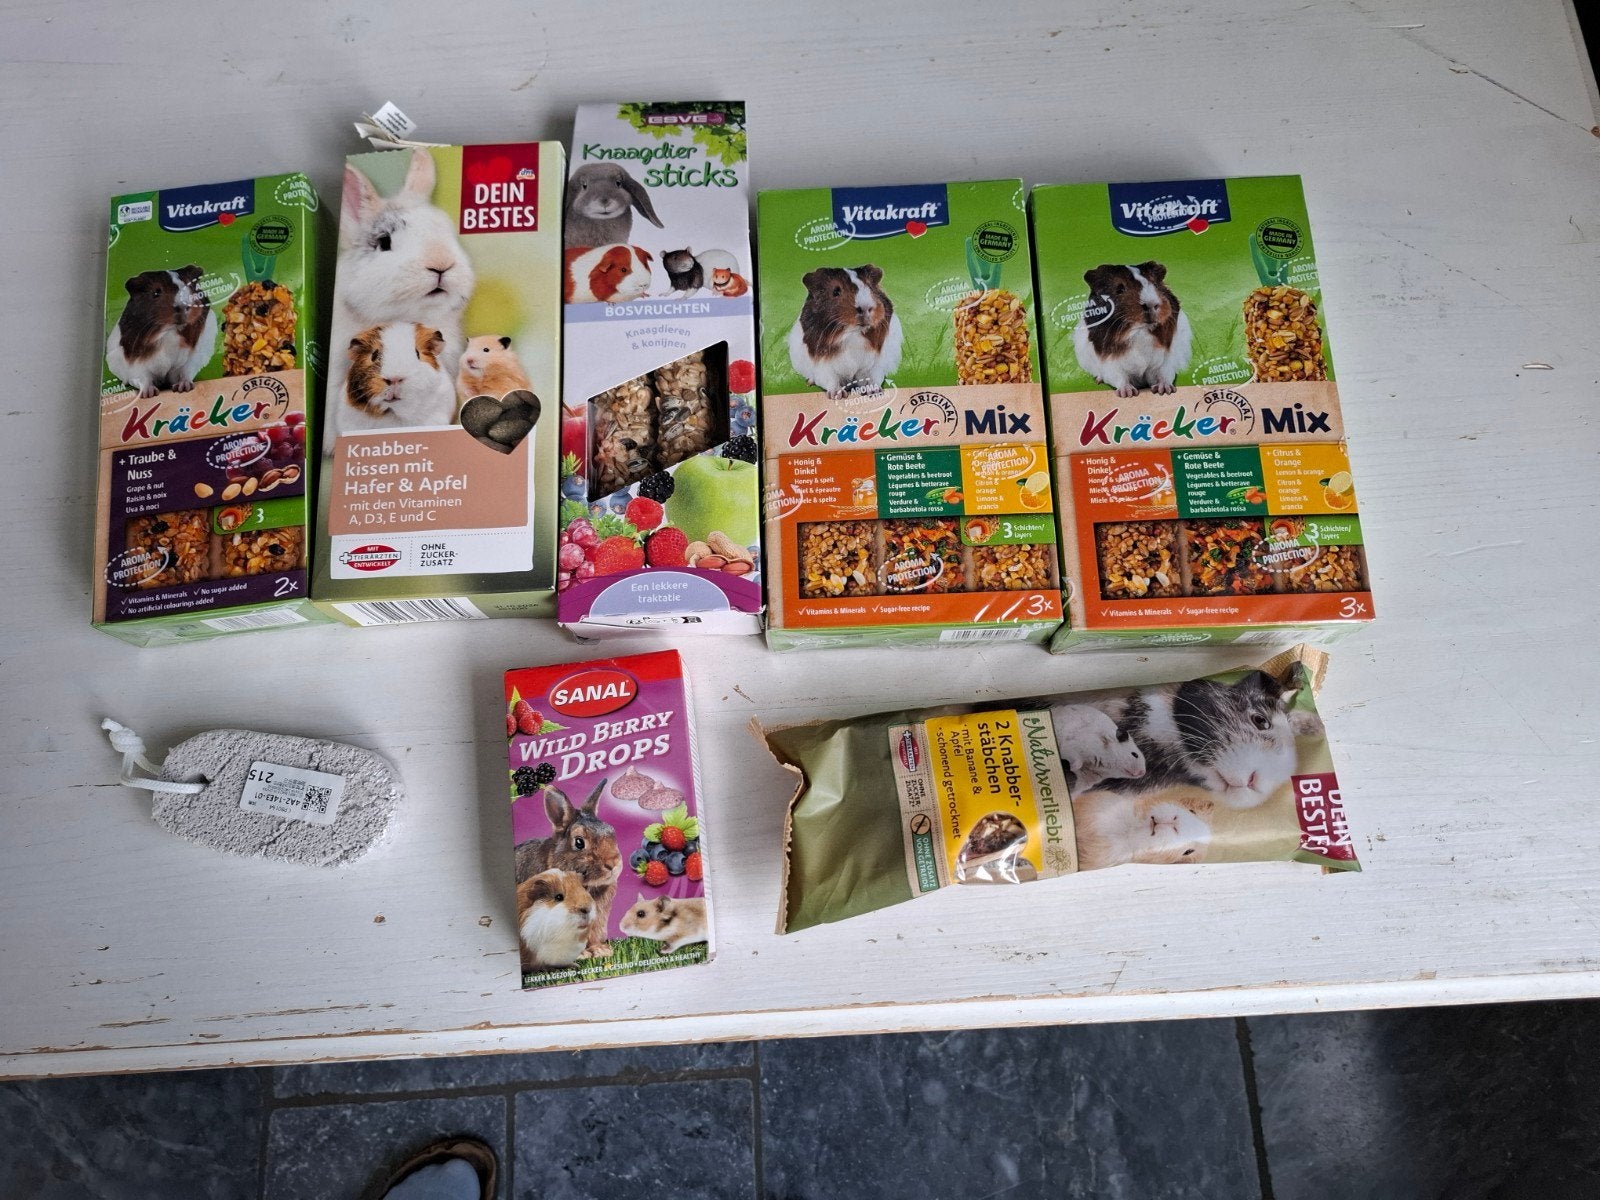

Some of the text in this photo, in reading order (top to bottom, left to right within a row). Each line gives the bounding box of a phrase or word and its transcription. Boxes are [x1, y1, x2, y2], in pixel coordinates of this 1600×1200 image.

[647, 114, 708, 124] ESVE
[582, 142, 697, 165] Knaagdier
[644, 161, 738, 187] sticks
[474, 182, 524, 203] DEIN
[166, 196, 246, 219] Vitakraft
[842, 202, 937, 223] Vitakraft
[1119, 198, 1218, 218] Vitakraft
[463, 205, 535, 230] BESTES
[810, 222, 837, 235] AROMA
[803, 229, 849, 245] PROTECTION
[195, 276, 223, 292] AROMA
[940, 281, 970, 295] AROMA
[188, 282, 234, 303] PROTECTION
[934, 289, 979, 305] PROTECTION
[605, 303, 710, 317] BOSVRUCHTEN
[1060, 305, 1107, 322] PROTECTION
[1067, 299, 1096, 312] AROMA
[625, 324, 691, 339] Knaagdieren
[641, 338, 687, 350] konijnen
[1209, 361, 1238, 375] AROMA
[1202, 369, 1250, 386] PROTECTION
[242, 376, 287, 405] ORIGINAL
[850, 383, 880, 396] AROMA
[910, 393, 954, 423] ORIGINAL
[1203, 391, 1250, 419] ORIGINAL
[121, 395, 267, 442] Kräcker
[788, 405, 1032, 448] Kräcker Mix
[1078, 403, 1331, 446] Kräcker Mix
[222, 436, 255, 451] AROMA
[347, 441, 429, 458] Knabber-
[128, 449, 177, 465] Traube &
[215, 442, 264, 463] PROTECTION
[886, 453, 915, 462] Gemüse
[988, 448, 1017, 461] AROMA
[1183, 451, 1213, 461] Gemüse
[1272, 447, 1292, 457] Citrus
[345, 458, 433, 476] kissen mit
[794, 457, 815, 468] Honig
[887, 461, 926, 471] Rote Beete
[1086, 457, 1109, 467] Honig
[1185, 460, 1225, 470] Rote Beete
[1274, 457, 1302, 467] Orange
[127, 468, 152, 481] Nuss
[794, 467, 818, 476] Dinkel
[887, 470, 953, 482] Vegetables beetroot
[1087, 466, 1111, 475] Dinkel
[1118, 467, 1149, 483] AROMA
[1186, 469, 1253, 481] Vegetables beetroot
[1276, 467, 1325, 476] Lemon orange
[127, 481, 165, 495] Grape nut
[344, 473, 467, 496] Hafer & Apfel
[794, 477, 812, 487] Honey
[887, 479, 950, 490] Légumes betterave
[1112, 475, 1162, 494] PROTECTION
[1186, 478, 1251, 490] Légumes betterave
[126, 490, 168, 504] Raisin noix
[888, 490, 907, 499] rouge
[1187, 489, 1207, 498] rouge
[1278, 487, 1300, 496] orange
[350, 496, 462, 512] mit den Vitaminen
[889, 498, 912, 507] Verdure
[1189, 497, 1213, 506] Verdure
[349, 510, 437, 525] A, D3, E und C
[1003, 521, 1013, 539] 3
[1308, 522, 1319, 538] 3
[421, 543, 446, 552] OHNE
[1268, 536, 1300, 552] AROMA
[120, 550, 151, 567] AROMA
[420, 558, 454, 567] ZUSATZ
[421, 550, 459, 559] ZUCKER-
[1262, 545, 1311, 565] PROTECTION
[113, 556, 162, 580] PROTECTION
[893, 556, 924, 571] AROMA
[887, 564, 936, 583] PROTECTION
[128, 581, 248, 605] Vitamins Minerals sugar added
[274, 576, 299, 597] 2x
[631, 581, 688, 592] Een lekkere
[136, 596, 214, 613] artificial colourings added
[638, 593, 682, 603] traktatie
[1026, 594, 1053, 615] 3x
[806, 603, 930, 616] Vitamins Minerals Sugar-free recipe
[1109, 604, 1239, 617] Vitamins Minerals Sugar-free recipe
[1338, 596, 1366, 617] 3x
[554, 681, 631, 705] SANAL
[519, 710, 674, 761] WILD BERRY
[950, 730, 963, 756] Apfel
[558, 733, 670, 781] DROPS
[961, 728, 982, 795] mit Banane &
[978, 721, 1001, 794] stäbchen
[995, 720, 1021, 806] 2 Knabber-
[247, 768, 274, 783] 215
[1022, 717, 1062, 845] Naturverliebt
[916, 777, 927, 797] OHNE
[936, 731, 960, 838] schonend getrocknet
[1299, 778, 1330, 854] BESTES
[1327, 789, 1351, 846] DEIN
[915, 836, 929, 889] VON GETREIDE
[922, 836, 936, 888] OHNE ZUSATZ
[524, 951, 701, 984] LEKKER GEZOND LECKER GESUND DELICIOUS HEALTHY
